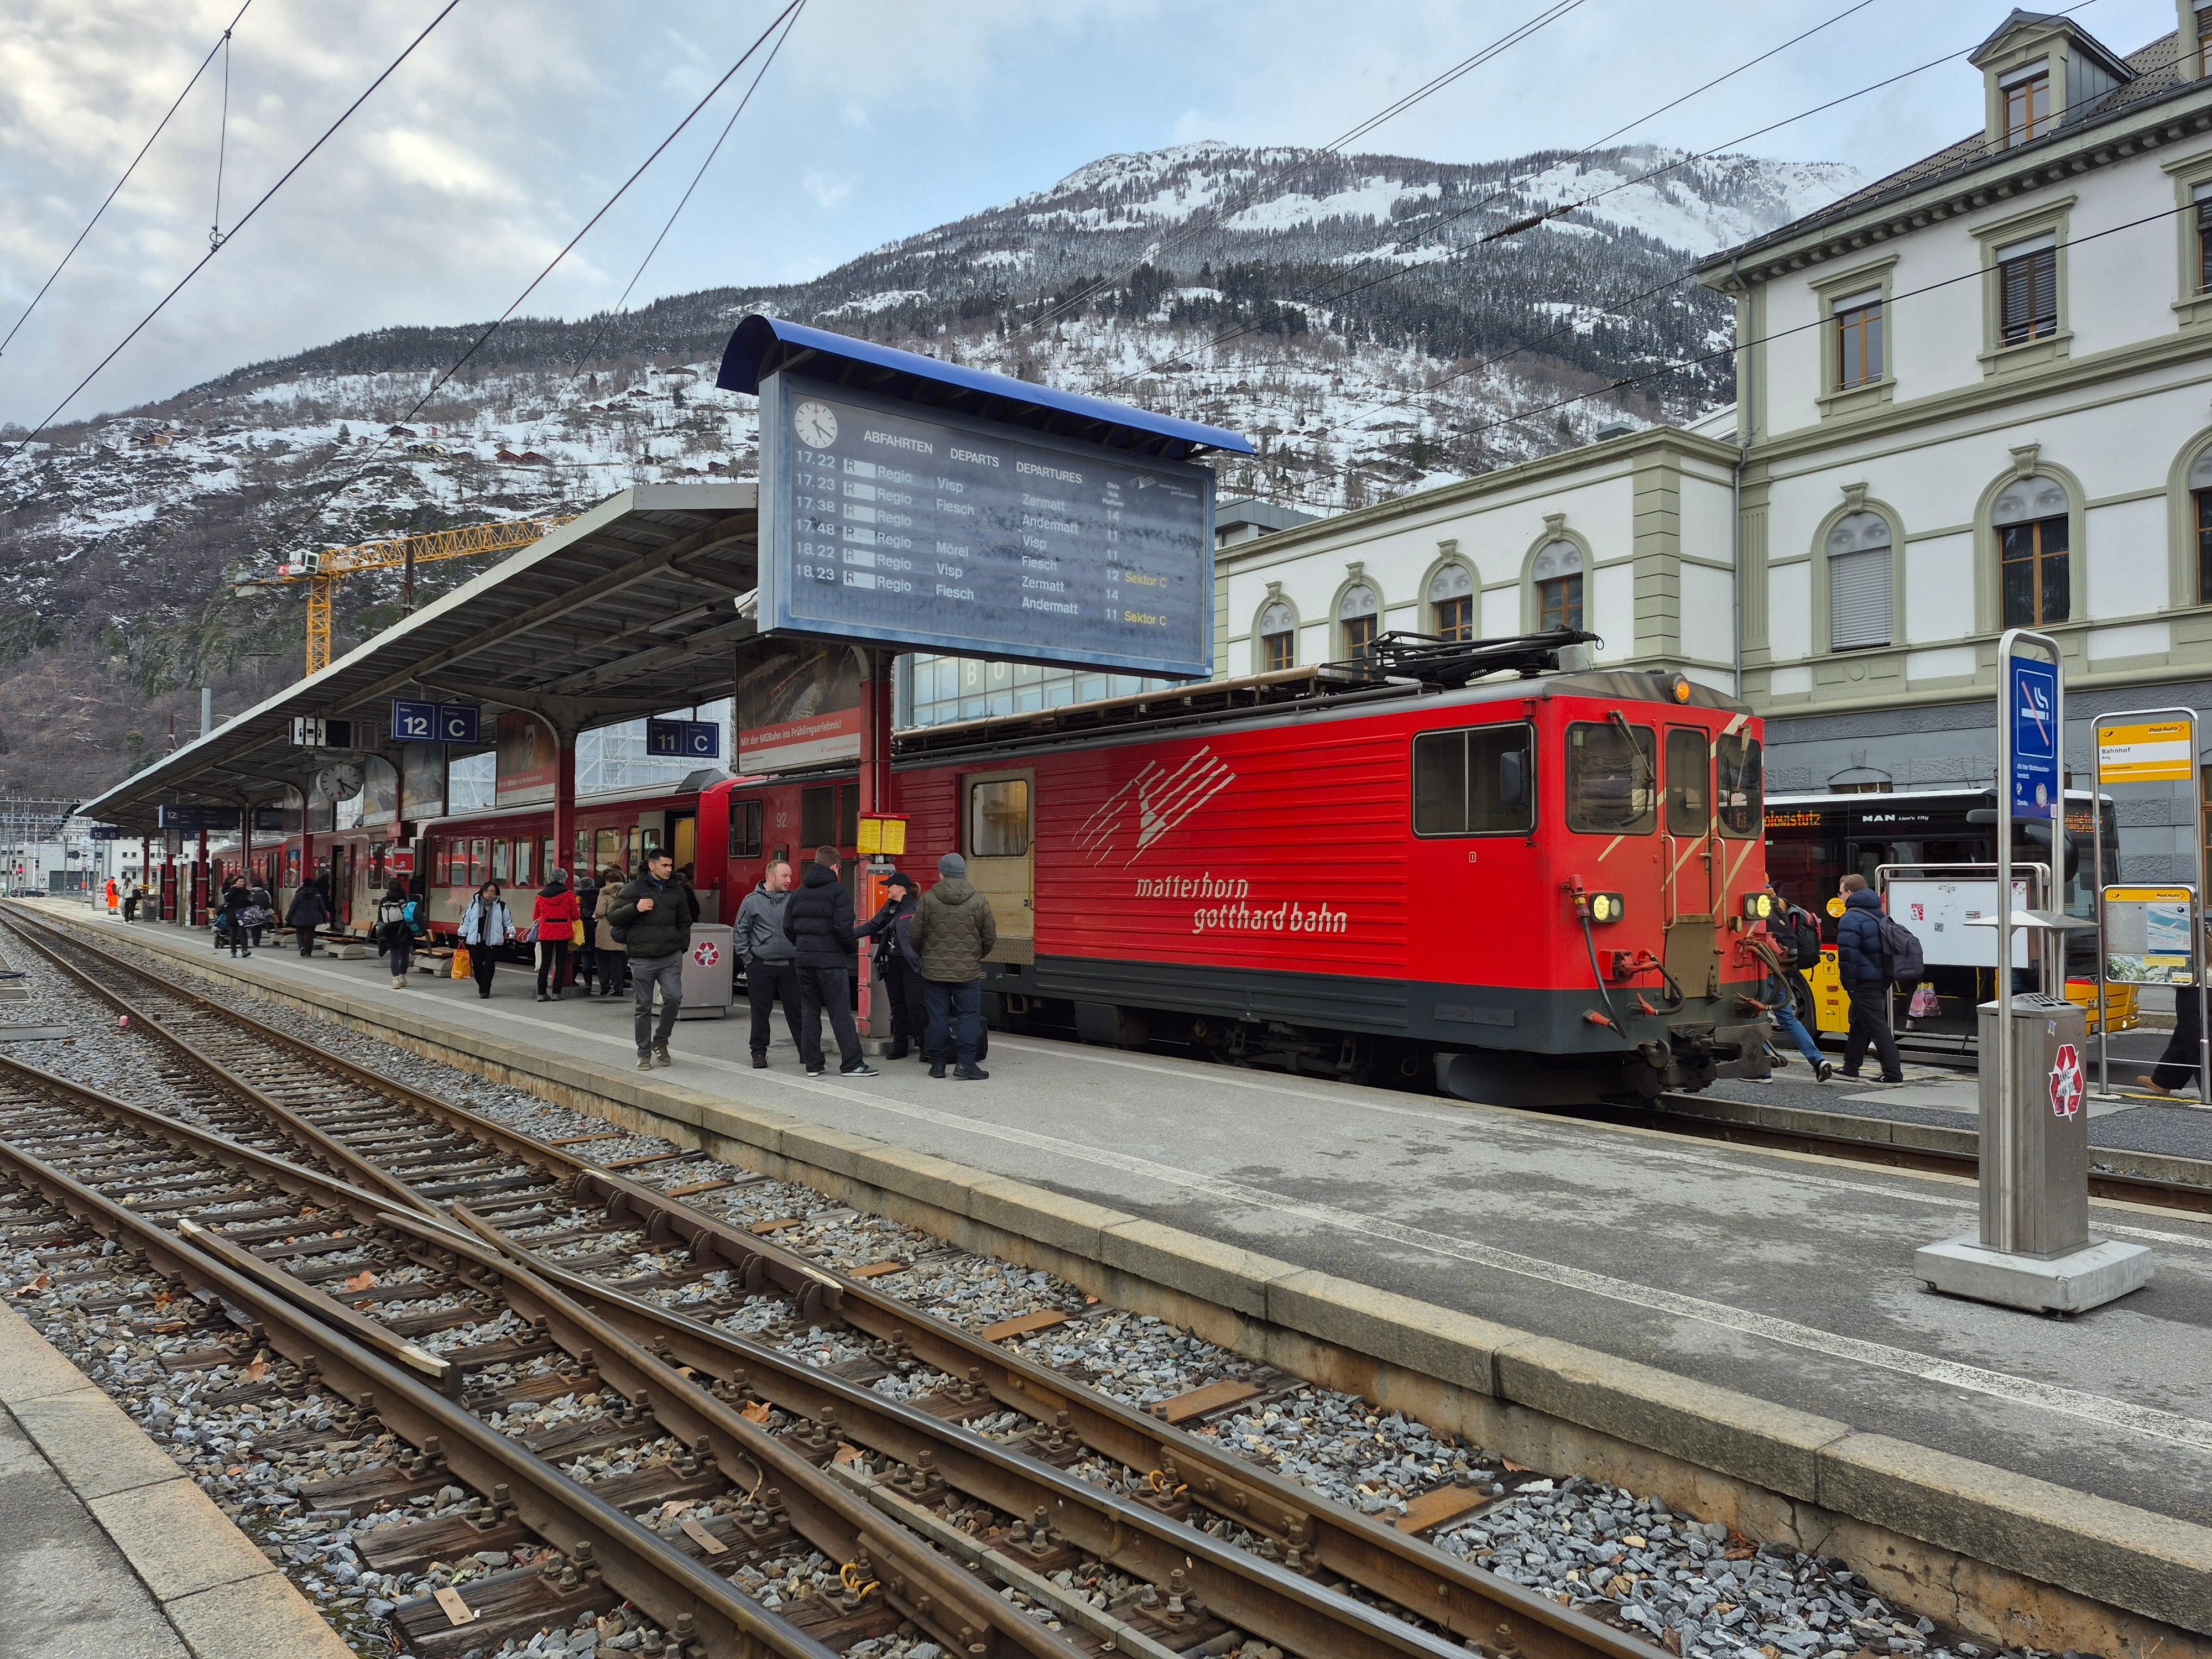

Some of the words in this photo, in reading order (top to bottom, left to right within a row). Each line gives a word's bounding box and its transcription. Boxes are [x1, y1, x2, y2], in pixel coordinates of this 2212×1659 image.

[864, 430, 933, 454] ABFAHRTEN
[951, 448, 999, 468] DEPARTS
[1016, 461, 1083, 484] DEPARTURES
[796, 450, 836, 469] 17.22
[847, 460, 855, 472] R
[877, 466, 912, 484] Regio
[937, 477, 963, 494] Visp
[1022, 493, 1065, 512] Zermatt
[1107, 510, 1120, 521] 14
[796, 472, 836, 491] 17.23
[847, 482, 855, 495] R
[877, 488, 912, 506] Regio
[936, 499, 975, 517] Fiesch
[1022, 514, 1079, 535] Andermatt
[1107, 530, 1118, 541] 11
[1102, 498, 1124, 507] Platform
[796, 495, 835, 513] 17.38
[847, 505, 855, 517] R
[877, 510, 912, 528] Regio
[1022, 534, 1047, 551] Visp
[1107, 550, 1118, 561] 11
[796, 518, 835, 535] 17.48
[847, 527, 855, 539] R
[877, 533, 912, 549] Regio
[936, 541, 968, 557] Mörel
[1022, 555, 1057, 571] Fiesch
[1107, 570, 1119, 581] 12
[1125, 572, 1156, 587] Sektor
[1160, 577, 1167, 588] C
[796, 541, 834, 559] 18.22
[847, 549, 855, 561] R
[877, 554, 912, 571] Regio
[937, 562, 963, 579] Visp
[1021, 576, 1065, 593] Zermatt
[1106, 589, 1119, 601] 14
[796, 564, 834, 581] 18.23
[846, 572, 855, 583] R
[877, 576, 912, 592] Regio
[936, 584, 974, 601] Fiesch
[1022, 597, 1078, 615] Andermatt
[1106, 608, 1117, 619] 11
[1124, 611, 1156, 625] Sektor
[1160, 616, 1167, 627] C
[403, 716, 427, 735] 12
[448, 719, 465, 737] C
[740, 737, 749, 747] Mit
[759, 731, 781, 743] MGBahn
[791, 719, 842, 737] Frühlingserlebnis!
[658, 734, 675, 750] 11
[694, 735, 708, 752] C
[776, 812, 787, 828] 92
[1863, 814, 1895, 822] MAN
[1135, 872, 1249, 899] matterhorn
[1192, 901, 1287, 934] gotthard
[1290, 902, 1348, 933] bahn
